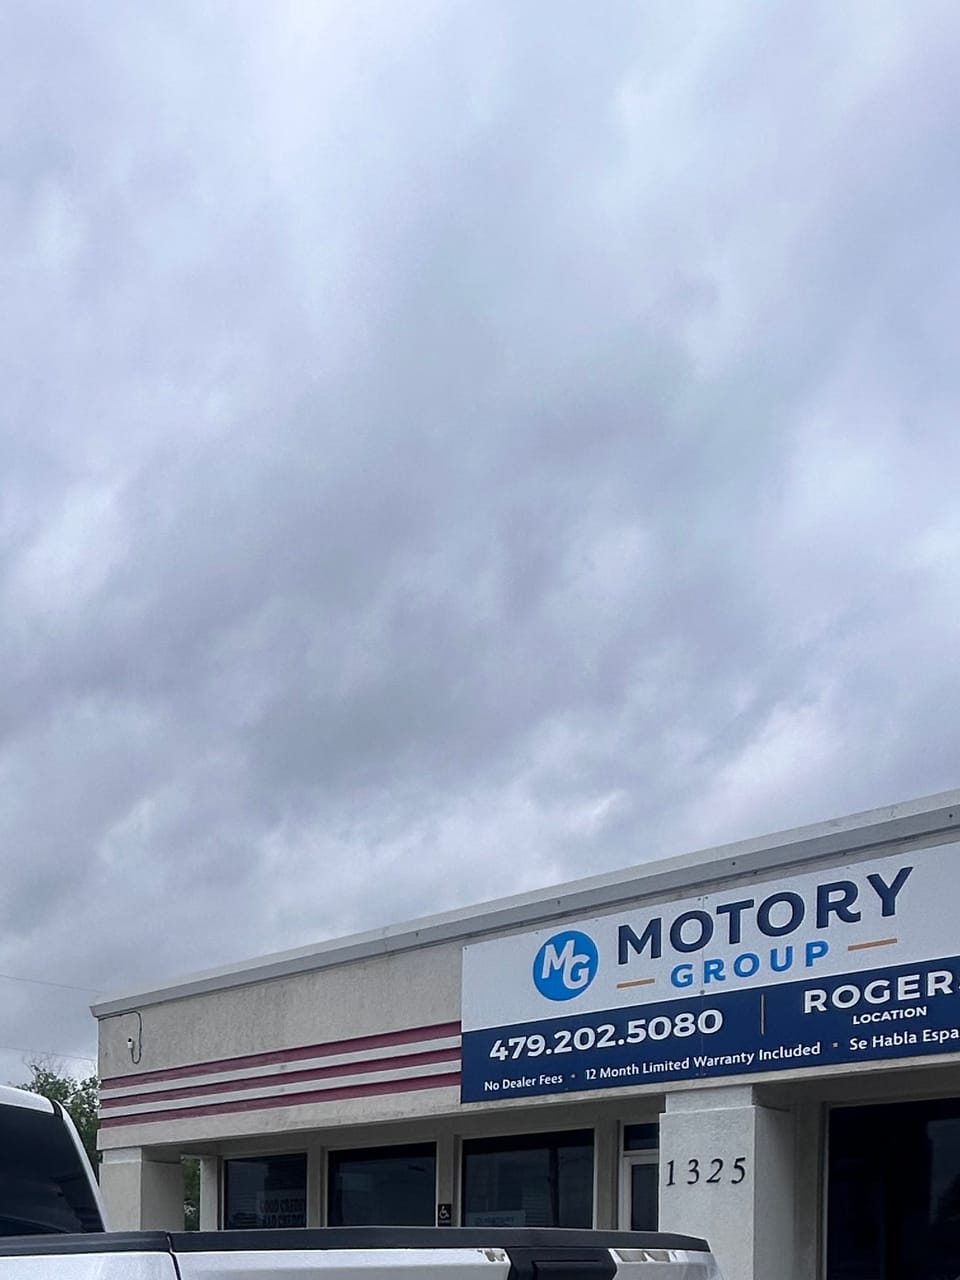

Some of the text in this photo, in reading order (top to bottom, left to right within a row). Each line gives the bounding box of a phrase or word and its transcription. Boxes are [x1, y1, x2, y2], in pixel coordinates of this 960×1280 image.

[617, 866, 914, 965] MOTORY
[541, 939, 591, 990] MG
[670, 940, 830, 988] GROUP
[803, 970, 960, 1014] ROGER
[852, 1006, 927, 1025] LOCATION
[489, 1009, 723, 1061] 479.202.5080
[484, 1028, 960, 1092] No Dealer Fees 12 Month Limited Warranty Included Se Habla Espa
[666, 1157, 746, 1187] 1325
